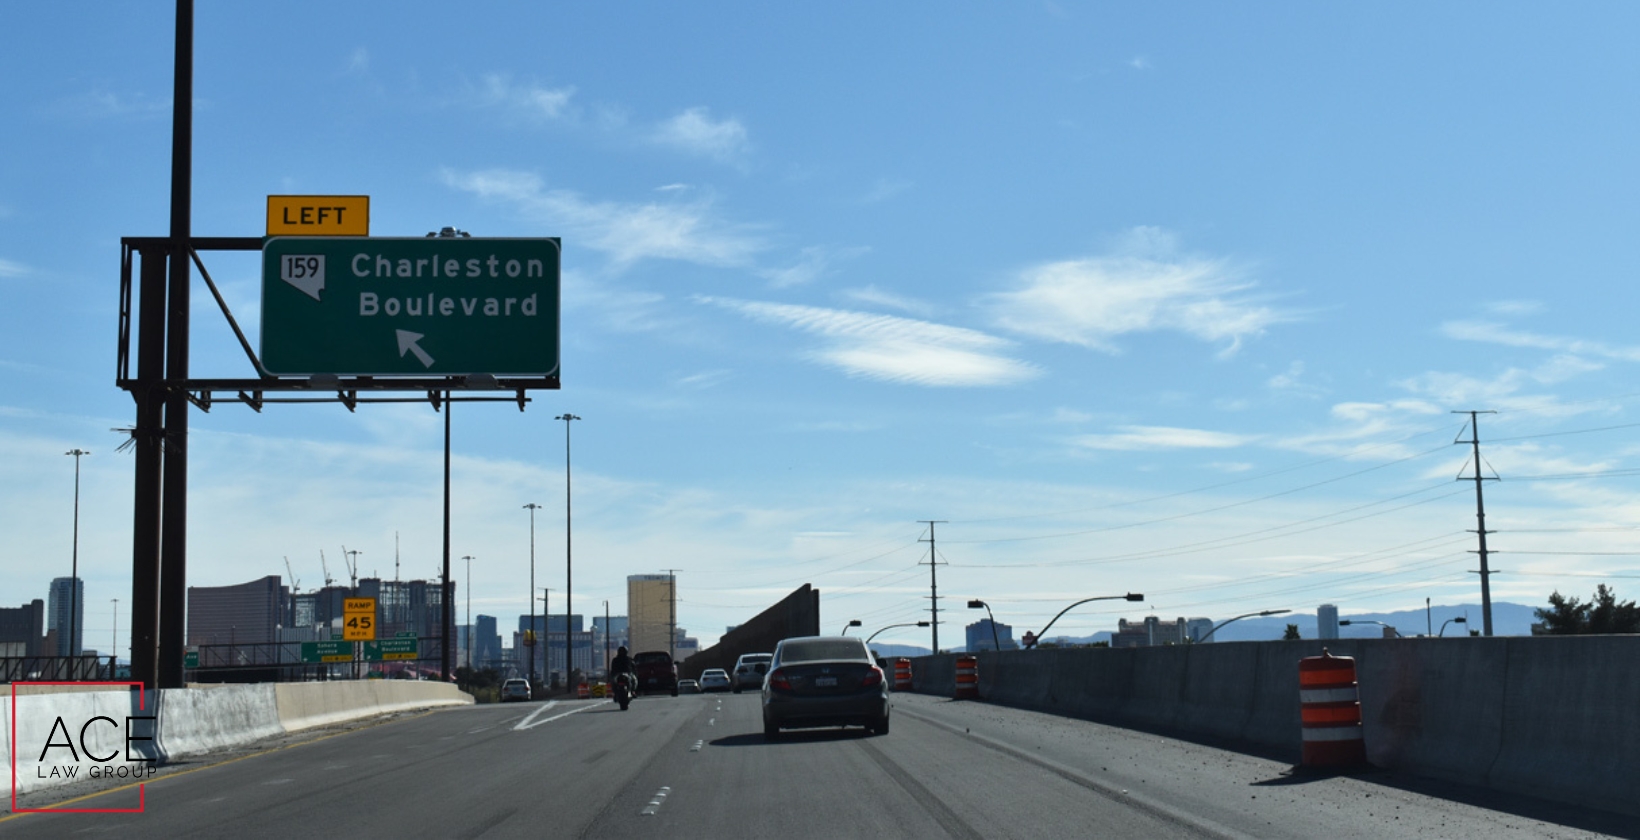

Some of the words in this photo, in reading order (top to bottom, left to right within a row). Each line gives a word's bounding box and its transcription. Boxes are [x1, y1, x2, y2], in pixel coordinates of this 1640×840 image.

[283, 206, 347, 225] LEFT
[287, 257, 319, 279] 159
[350, 252, 544, 278] Charleston
[359, 292, 538, 317] Boulevard
[347, 617, 371, 629] 45
